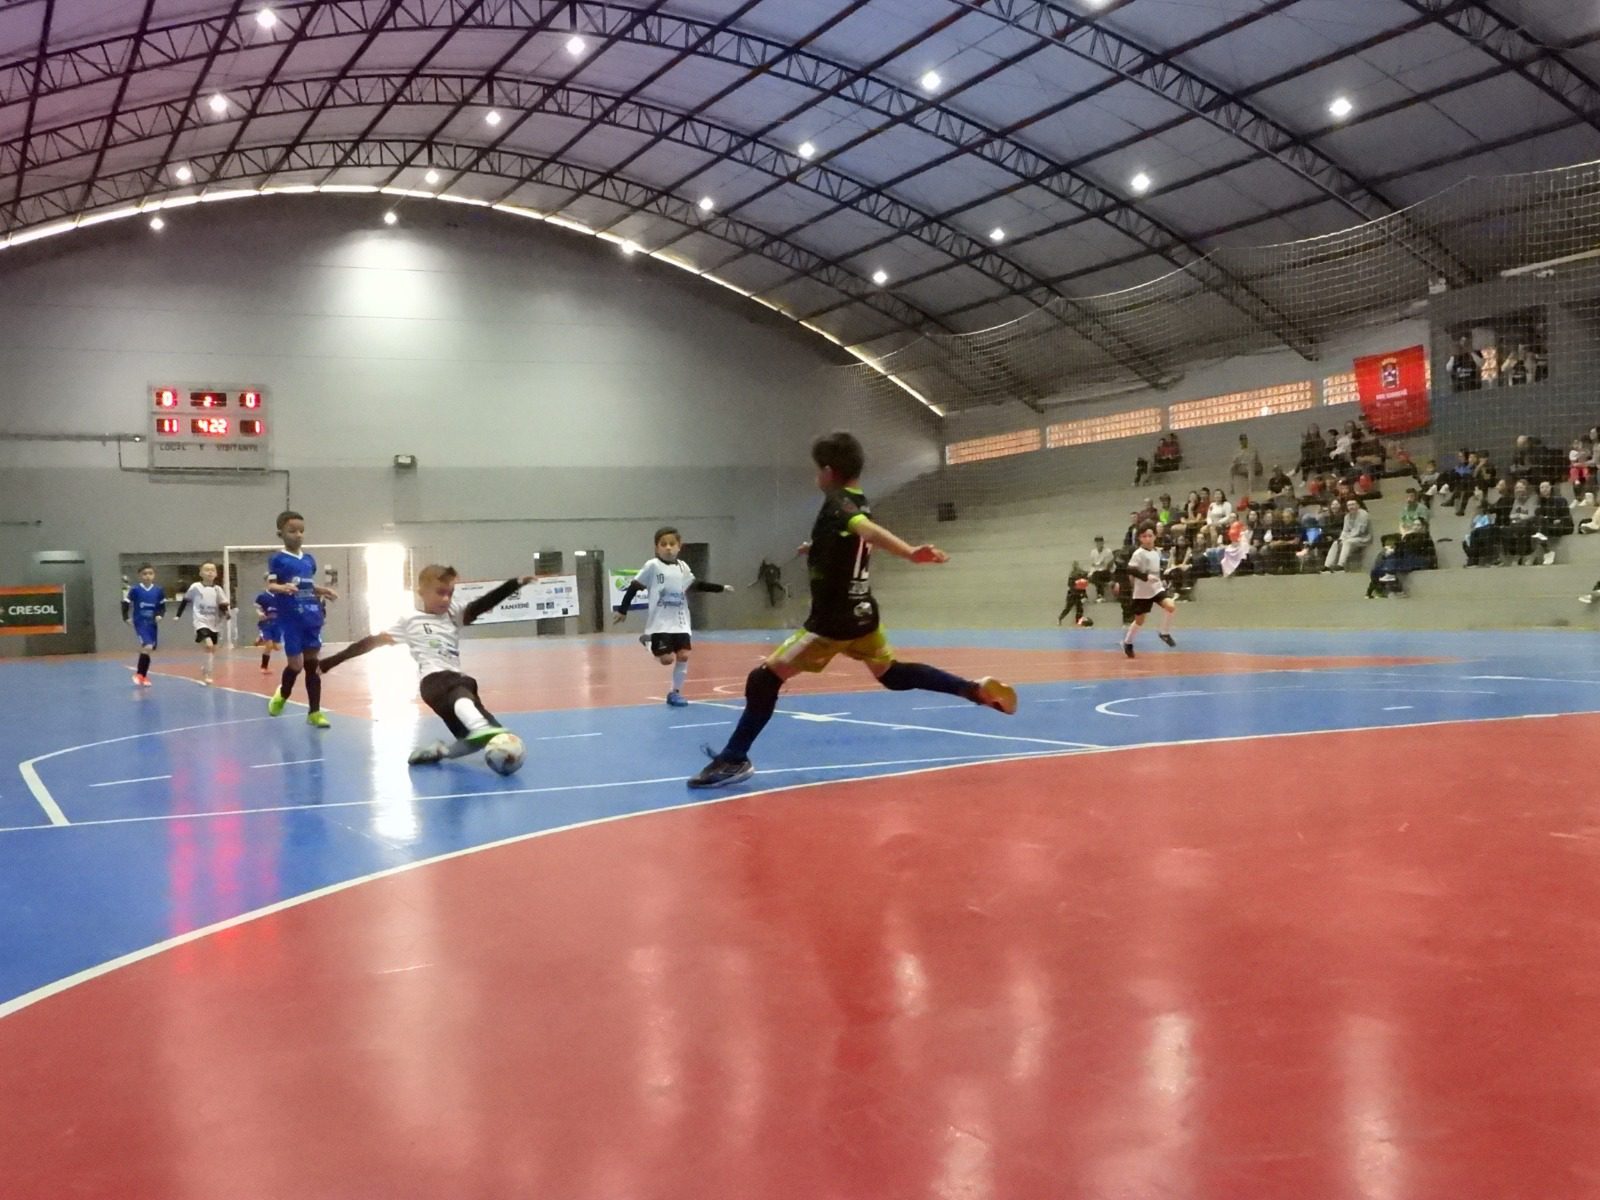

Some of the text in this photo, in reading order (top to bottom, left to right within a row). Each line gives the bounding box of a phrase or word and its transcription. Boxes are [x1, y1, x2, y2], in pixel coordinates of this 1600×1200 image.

[162, 391, 173, 407] 0
[245, 392, 256, 408] 0
[164, 419, 178, 432] 11
[656, 573, 665, 585] 10
[8, 604, 58, 615] CRESOL
